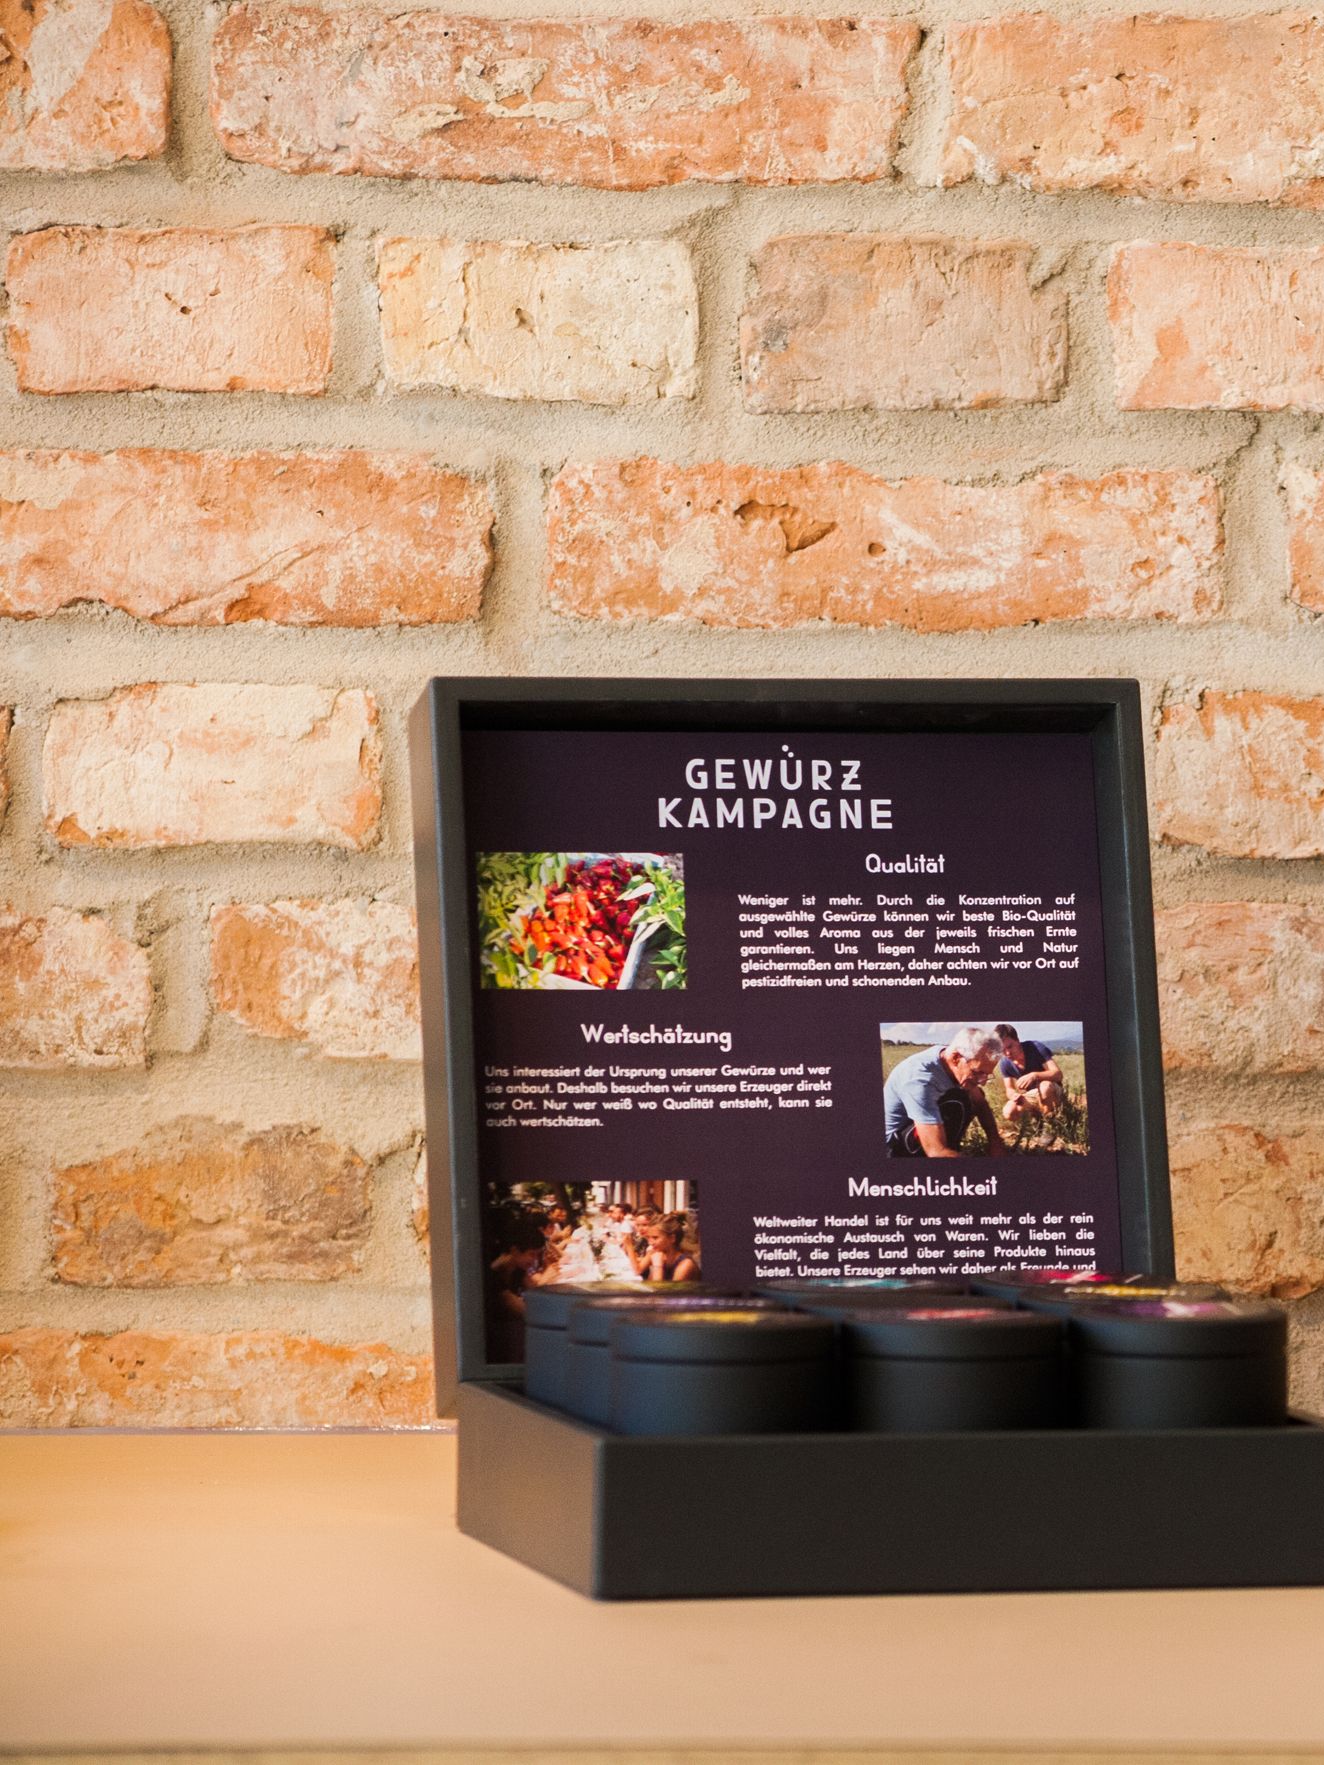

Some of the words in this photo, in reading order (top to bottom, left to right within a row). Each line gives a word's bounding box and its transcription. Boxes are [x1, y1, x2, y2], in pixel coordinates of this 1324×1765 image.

[685, 745, 862, 790] GEWÜRZ
[657, 798, 893, 829] KAMPAGNE
[865, 853, 946, 873] Qualität
[737, 894, 790, 908] Weniger
[801, 895, 817, 905] ist
[828, 894, 863, 905] mehr.
[876, 894, 913, 905] Durch
[925, 894, 946, 905] die
[958, 894, 1042, 905] Konzentration
[1054, 893, 1076, 904] auf
[738, 910, 816, 924] ausgewählte
[822, 911, 877, 921] Gewürze
[883, 910, 930, 921] können
[935, 911, 956, 921] wir
[962, 910, 995, 921] beste
[1001, 910, 1077, 921] Bio-Qualität
[739, 927, 764, 938] und
[773, 927, 810, 938] volles
[819, 927, 862, 938] Aroma
[871, 930, 894, 938] aus
[904, 926, 926, 937] der
[935, 926, 978, 940] jeweils
[987, 926, 1035, 937] frischen
[1045, 926, 1078, 936] Ernte
[739, 943, 815, 957] garantieren.
[834, 943, 859, 954] Uns
[877, 943, 916, 956] liegen
[934, 942, 981, 953] Mensch
[999, 942, 1024, 953] und
[1042, 942, 1079, 952] Natur
[740, 959, 832, 973] gleichermaßen
[834, 962, 855, 970] am
[857, 959, 905, 971] Herzen,
[907, 959, 945, 970] daher
[946, 958, 988, 969] achten
[989, 958, 1010, 969] wir
[1011, 961, 1033, 969] vor
[1034, 958, 1057, 968] Ort
[1058, 957, 1080, 968] auf
[741, 975, 823, 989] pestizidfreien
[824, 975, 850, 986] und
[851, 975, 925, 986] schonenden
[927, 975, 972, 985] Anbau.
[580, 1024, 732, 1052] Wertschätzung
[484, 1067, 510, 1077] Uns
[512, 1066, 581, 1077] interessiert
[583, 1066, 606, 1077] der
[608, 1066, 667, 1079] Ursprung
[670, 1068, 718, 1076] unserer
[720, 1065, 777, 1076] Gewürze
[779, 1064, 805, 1075] und
[806, 1067, 832, 1075] wer
[485, 1083, 504, 1093] sie
[505, 1082, 554, 1093] anbaut.
[556, 1082, 609, 1093] Deshalb
[610, 1082, 670, 1093] besuchen
[671, 1082, 693, 1092] wir
[694, 1084, 738, 1093] unsere
[739, 1081, 795, 1094] Erzeuger
[796, 1080, 833, 1091] direkt
[485, 1102, 507, 1110] vor
[511, 1099, 537, 1110] Ort.
[542, 1099, 569, 1110] Nur
[572, 1102, 598, 1110] wer
[601, 1098, 634, 1110] weiß
[662, 1098, 715, 1110] Qualität
[719, 1097, 773, 1110] entsteht,
[778, 1097, 810, 1108] kann
[814, 1096, 833, 1107] sie
[486, 1116, 517, 1126] auch
[519, 1115, 604, 1127] wertschätzen.
[848, 1176, 998, 1196] Menschlichkeit
[752, 1216, 819, 1227] Weltweiter
[824, 1215, 869, 1226] Handel
[875, 1215, 890, 1226] ist
[894, 1214, 914, 1226] für
[919, 1217, 942, 1225] uns
[947, 1214, 974, 1225] weit
[980, 1213, 1013, 1224] mehr
[1018, 1213, 1037, 1224] als
[1042, 1213, 1064, 1224] der
[1069, 1212, 1094, 1223] rein
[753, 1232, 835, 1244] ökonomische
[842, 1231, 905, 1243] Austausch
[913, 1234, 937, 1242] von
[944, 1231, 989, 1241] Waren.
[997, 1230, 1021, 1240] Wir
[1028, 1229, 1067, 1240] lieben
[1075, 1228, 1095, 1239] die
[753, 1249, 802, 1261] Vielfalt,
[809, 1248, 830, 1260] die
[837, 1248, 871, 1262] jedes
[878, 1247, 909, 1259] Land
[916, 1247, 946, 1258] über
[952, 1247, 986, 1258] seine
[993, 1245, 1047, 1257] Produkte
[1055, 1245, 1096, 1256] hinaus
[755, 1266, 794, 1277] bietet.
[797, 1265, 842, 1276] Unsere
[843, 1264, 898, 1280] Erzeuger
[899, 1264, 937, 1275] sehen
[938, 1263, 959, 1274] wir
[960, 1263, 997, 1274] daher
